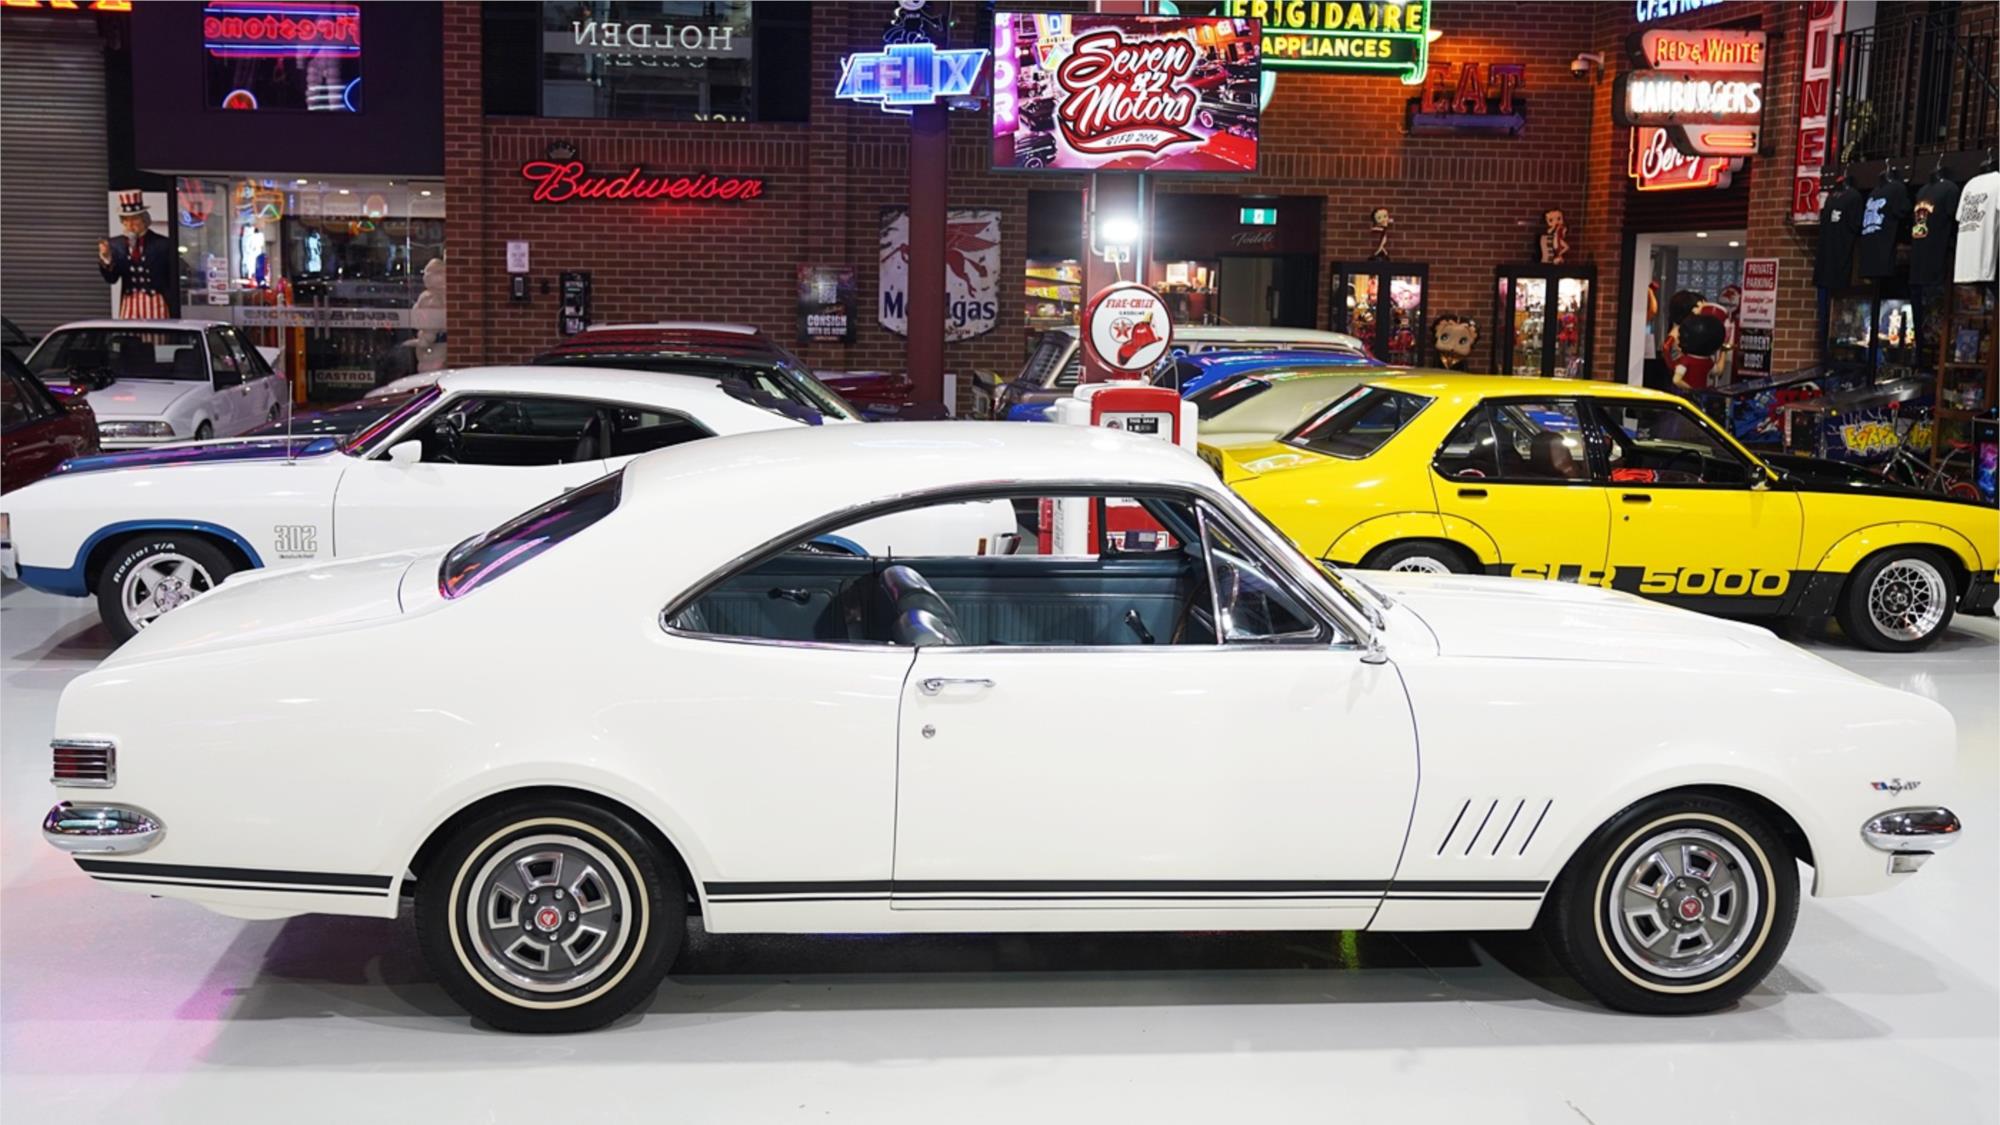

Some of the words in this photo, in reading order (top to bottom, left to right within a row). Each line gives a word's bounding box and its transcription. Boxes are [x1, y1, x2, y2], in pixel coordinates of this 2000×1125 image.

[1232, 1, 1422, 32] FRIGIDAIRE
[1261, 37, 1391, 57] APPLIANCES
[1657, 38, 1686, 62] RED
[1690, 45, 1701, 64] &
[1705, 38, 1760, 63] WHITE
[853, 54, 970, 95] FELIX
[1064, 37, 1188, 89] Seven
[1131, 71, 1167, 92] 82
[1420, 63, 1524, 114] EAT
[1066, 82, 1190, 133] Motors
[1630, 80, 1762, 114] HAMBURGERS
[522, 161, 763, 202] Budweiser
[1746, 277, 1774, 289] PARKING
[1748, 263, 1775, 275] PRIVATE
[807, 314, 848, 327] CONSIGN
[316, 371, 373, 380] CASTROL
[274, 525, 317, 552] 302
[113, 547, 149, 583] Radial
[152, 542, 176, 550] T/A
[1639, 568, 1790, 596] 5000
